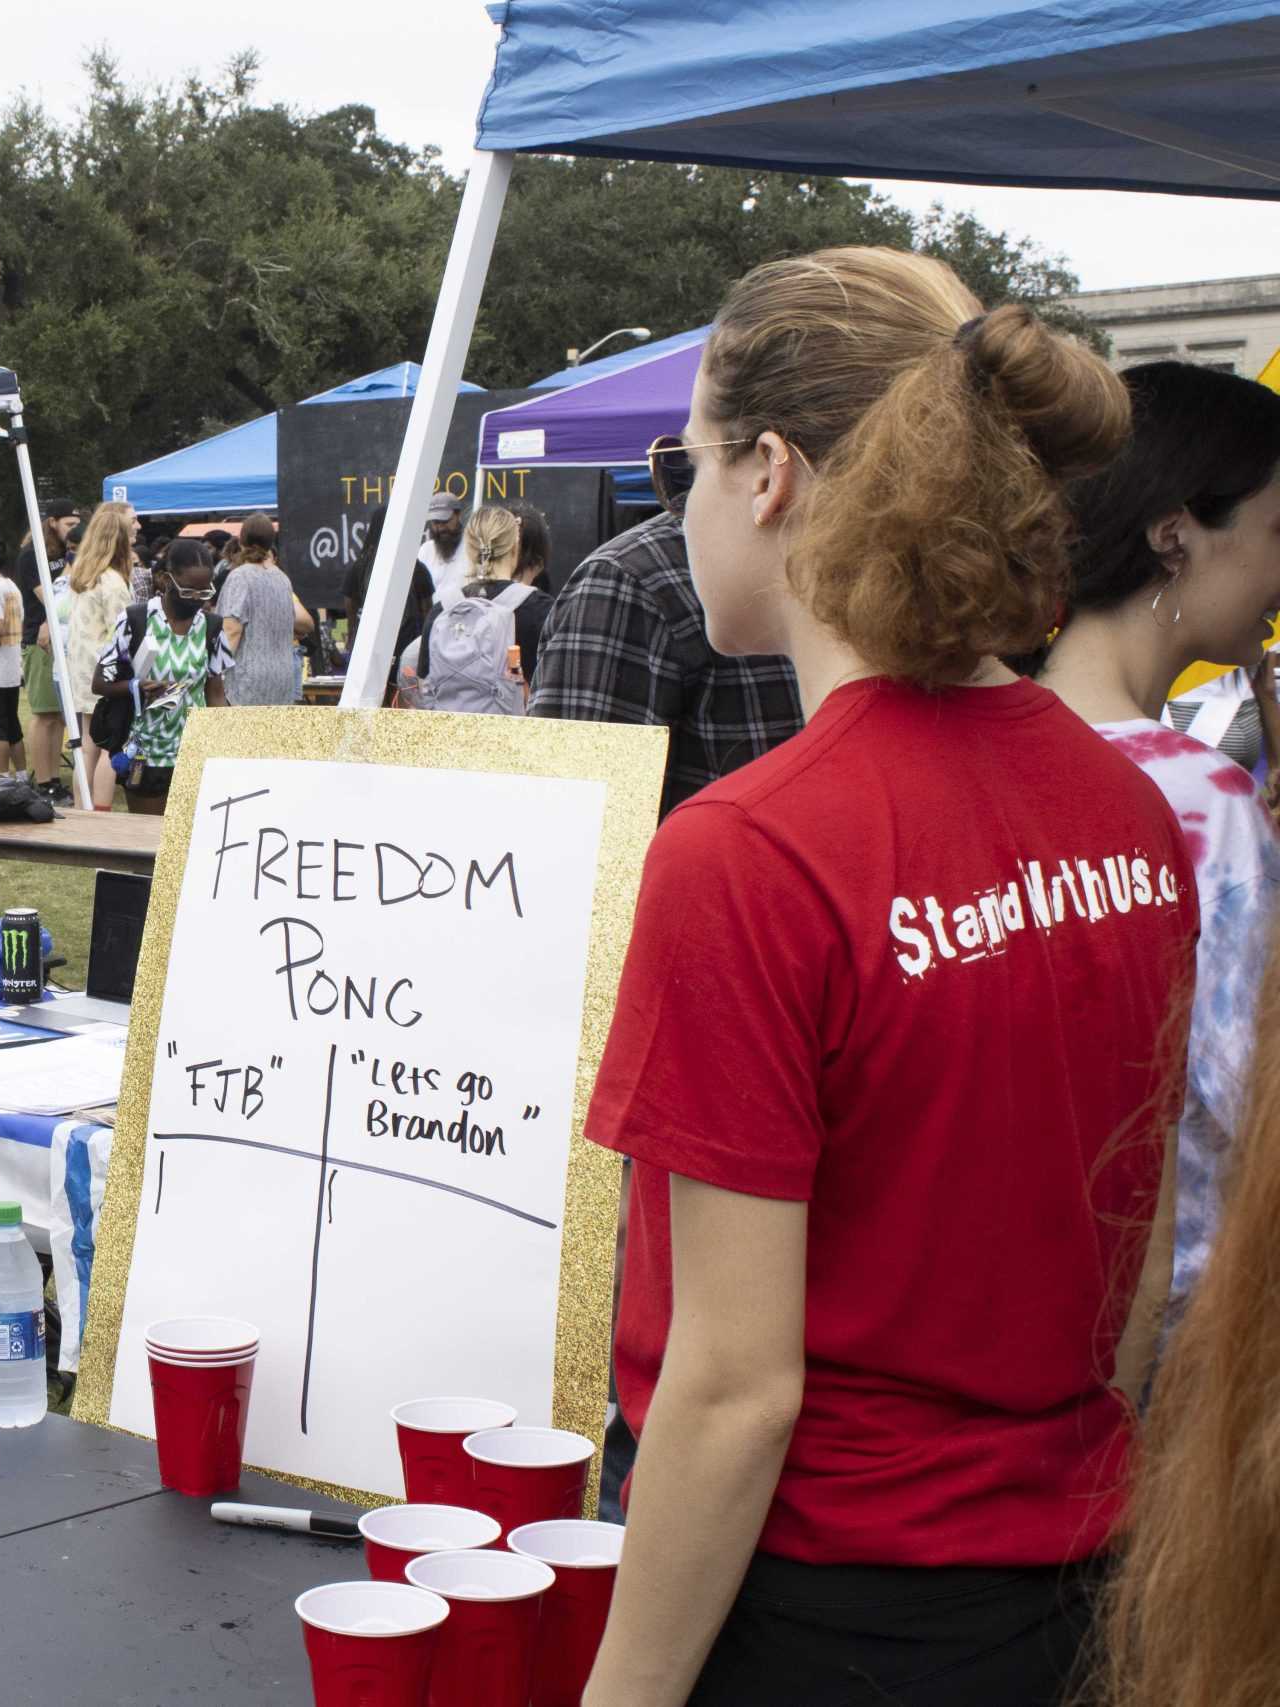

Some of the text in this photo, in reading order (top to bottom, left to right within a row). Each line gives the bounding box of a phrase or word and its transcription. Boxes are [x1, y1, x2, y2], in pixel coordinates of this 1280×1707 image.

[210, 788, 523, 918] FREEDOM
[260, 917, 423, 1027] PONG
[456, 1071, 494, 1105] go
